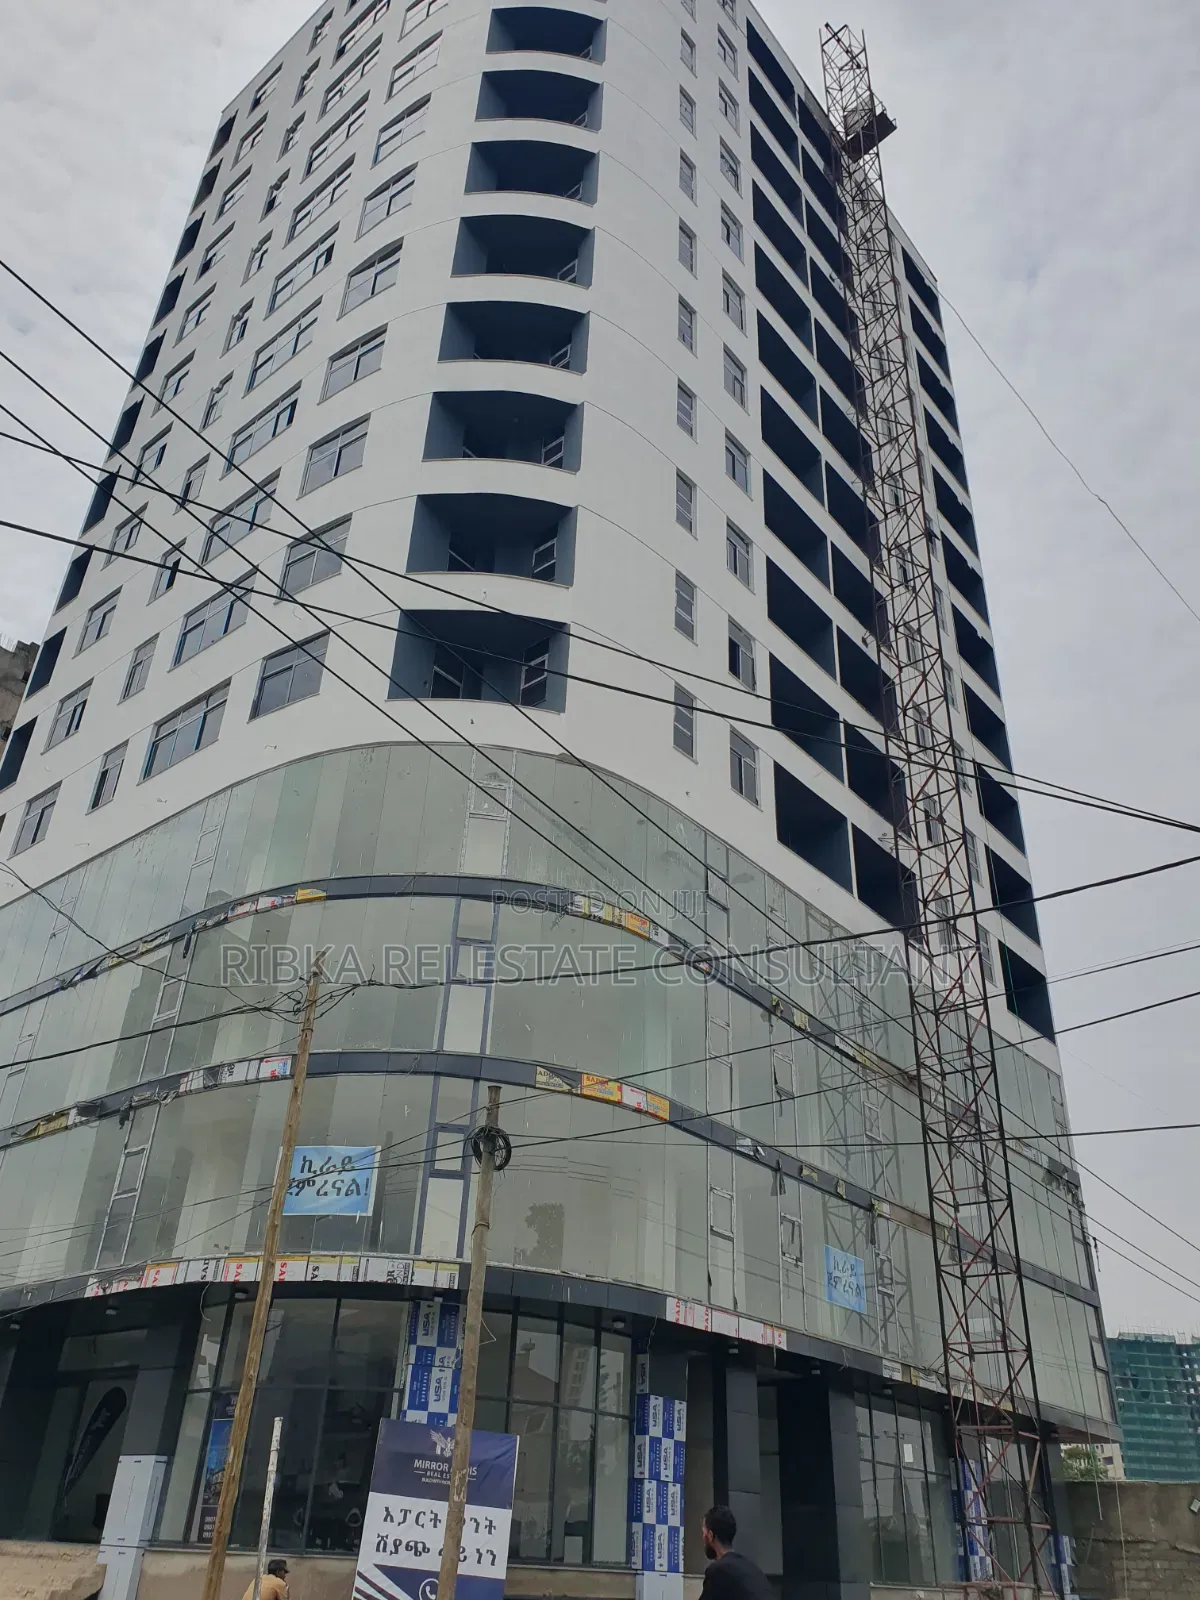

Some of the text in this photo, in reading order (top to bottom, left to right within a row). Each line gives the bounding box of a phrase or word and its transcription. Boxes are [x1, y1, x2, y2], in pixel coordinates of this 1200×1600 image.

[413, 1459, 449, 1473] MIRROR
[426, 1470, 442, 1478] REAL
[382, 1506, 497, 1535] አፓርትንት
